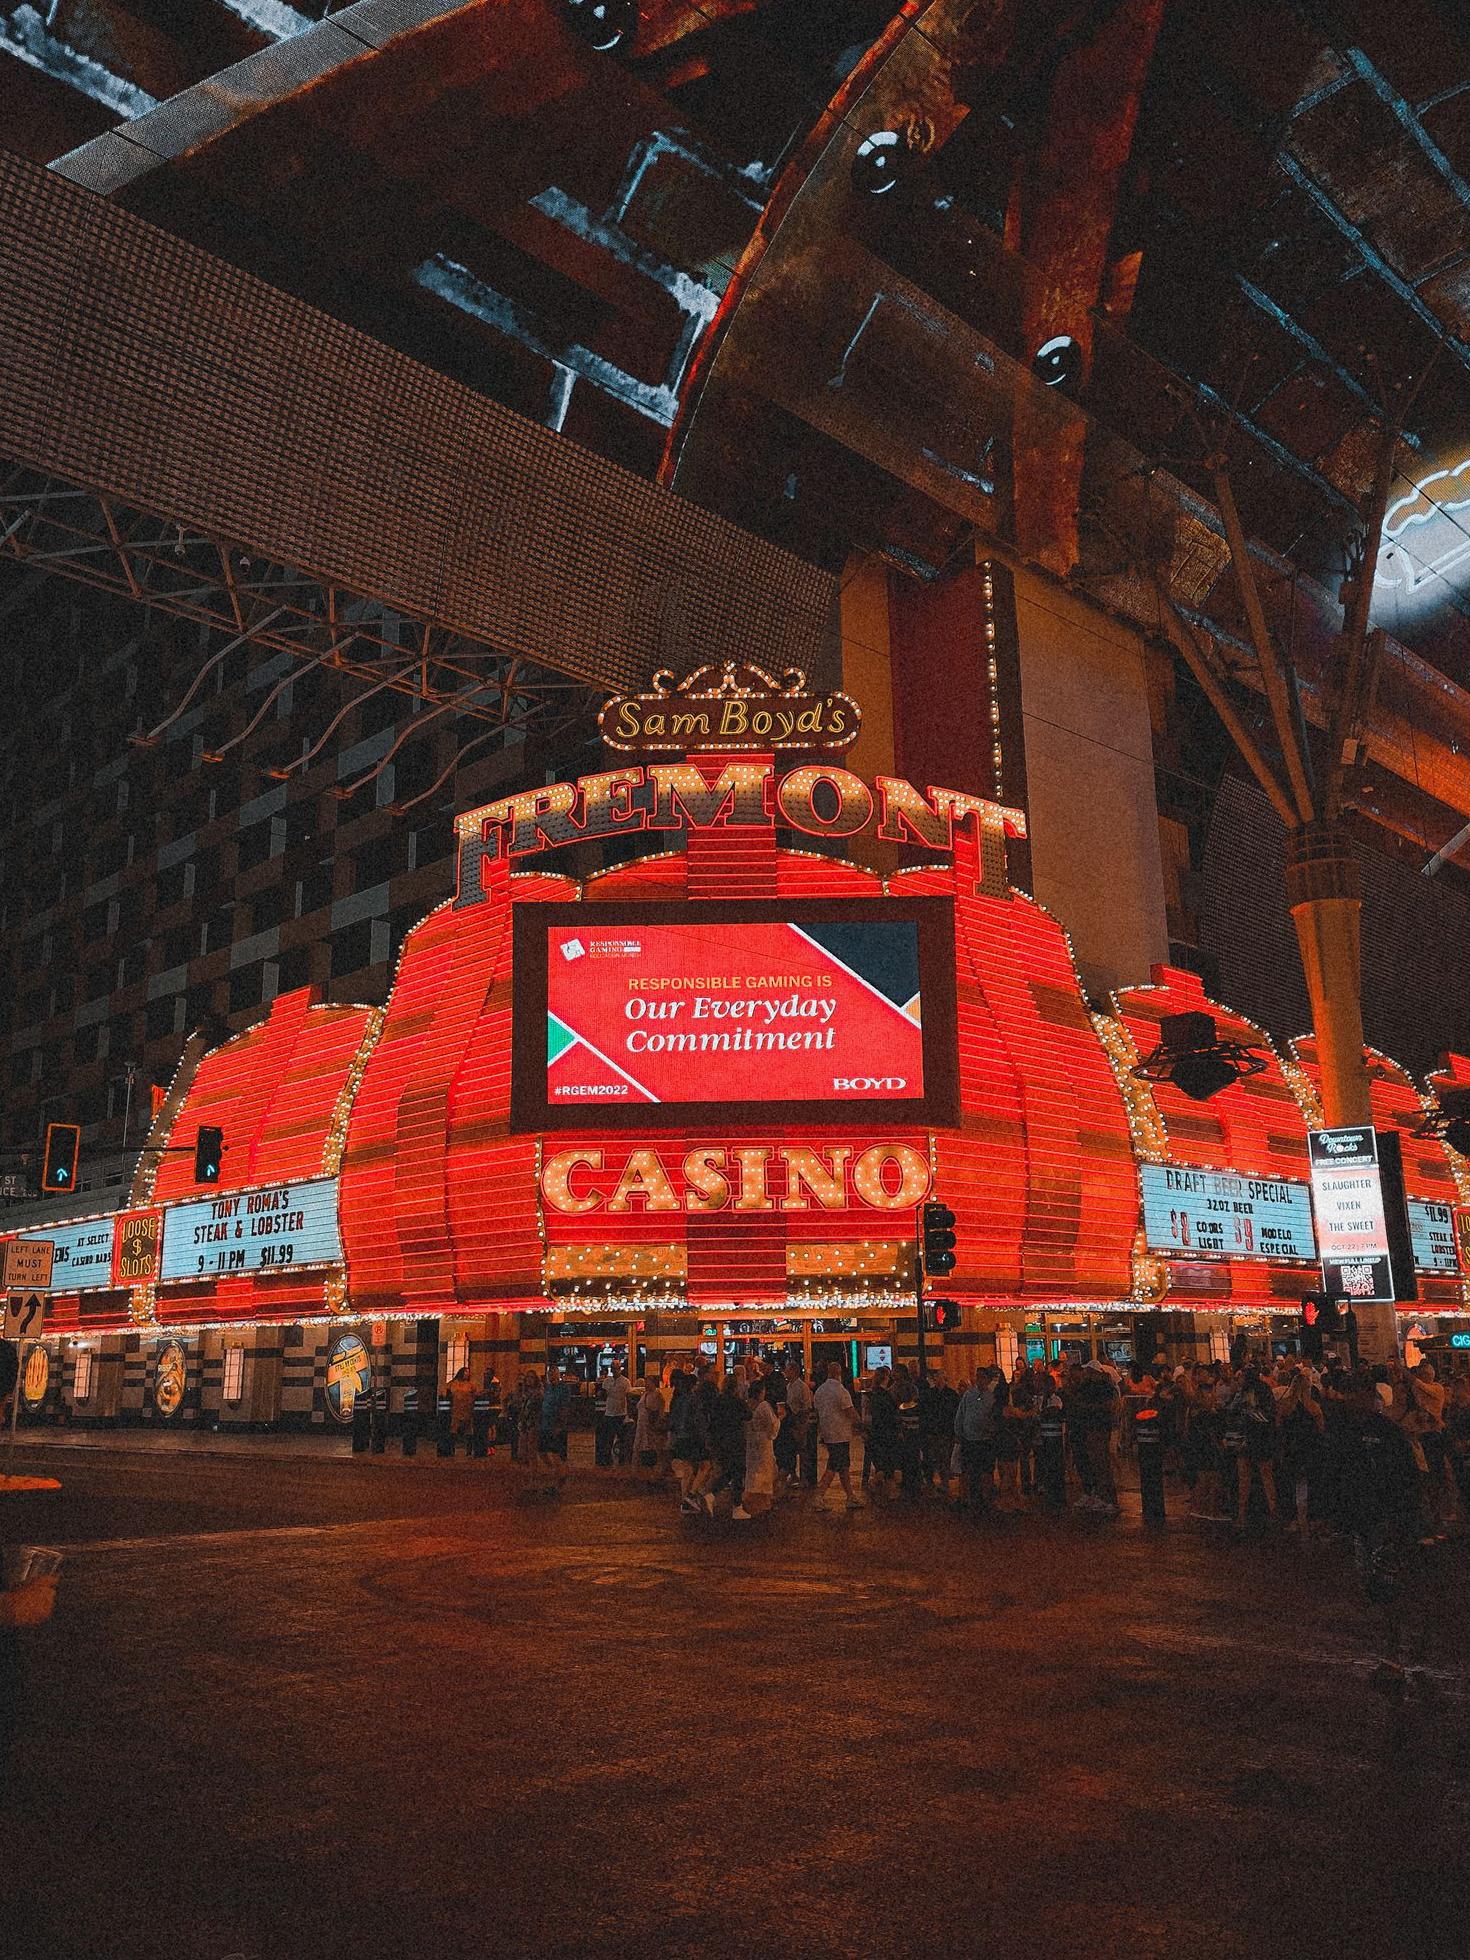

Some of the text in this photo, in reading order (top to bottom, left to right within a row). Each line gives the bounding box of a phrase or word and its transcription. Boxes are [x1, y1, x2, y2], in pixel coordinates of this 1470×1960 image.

[616, 698, 847, 741] Sam Boyd's
[453, 762, 1028, 914] FREMONT
[628, 976, 833, 990] RESPONSIBLE GAMING IS
[625, 994, 838, 1024] Our Everyday
[626, 1027, 837, 1053] Commitment
[833, 1077, 907, 1090] BOYD
[554, 1085, 629, 1097] #RGEM2022
[1319, 1134, 1364, 1145] Downtown
[1315, 1155, 1373, 1166] FREE CONCERT
[542, 1143, 930, 1215] CASINO
[1322, 1179, 1372, 1191] SLAUGHTER
[1166, 1169, 1293, 1204] DRAFT BEER SPECIAL
[211, 1190, 290, 1221] TONY ROMA'S
[1233, 1202, 1254, 1215] BEER
[1336, 1200, 1361, 1210] VIXEN
[1425, 1205, 1449, 1223] $11.99
[122, 1217, 156, 1243] LOOSE
[194, 1211, 304, 1245] STEAK & LOBSTER
[1196, 1221, 1224, 1235] COORS
[1329, 1221, 1374, 1233] THE SWEET
[86, 1233, 110, 1246] SELECT
[1261, 1228, 1292, 1241] MODELO
[11, 1245, 51, 1254] LEFT LANE
[1199, 1236, 1224, 1250] LIGHT
[1260, 1242, 1299, 1256] ESPECIAL
[16, 1259, 42, 1268] MUST
[198, 1255, 205, 1273] 9
[260, 1244, 294, 1268] $11.99
[121, 1254, 152, 1278] SLOTS
[8, 1273, 48, 1282] TURN LEFT
